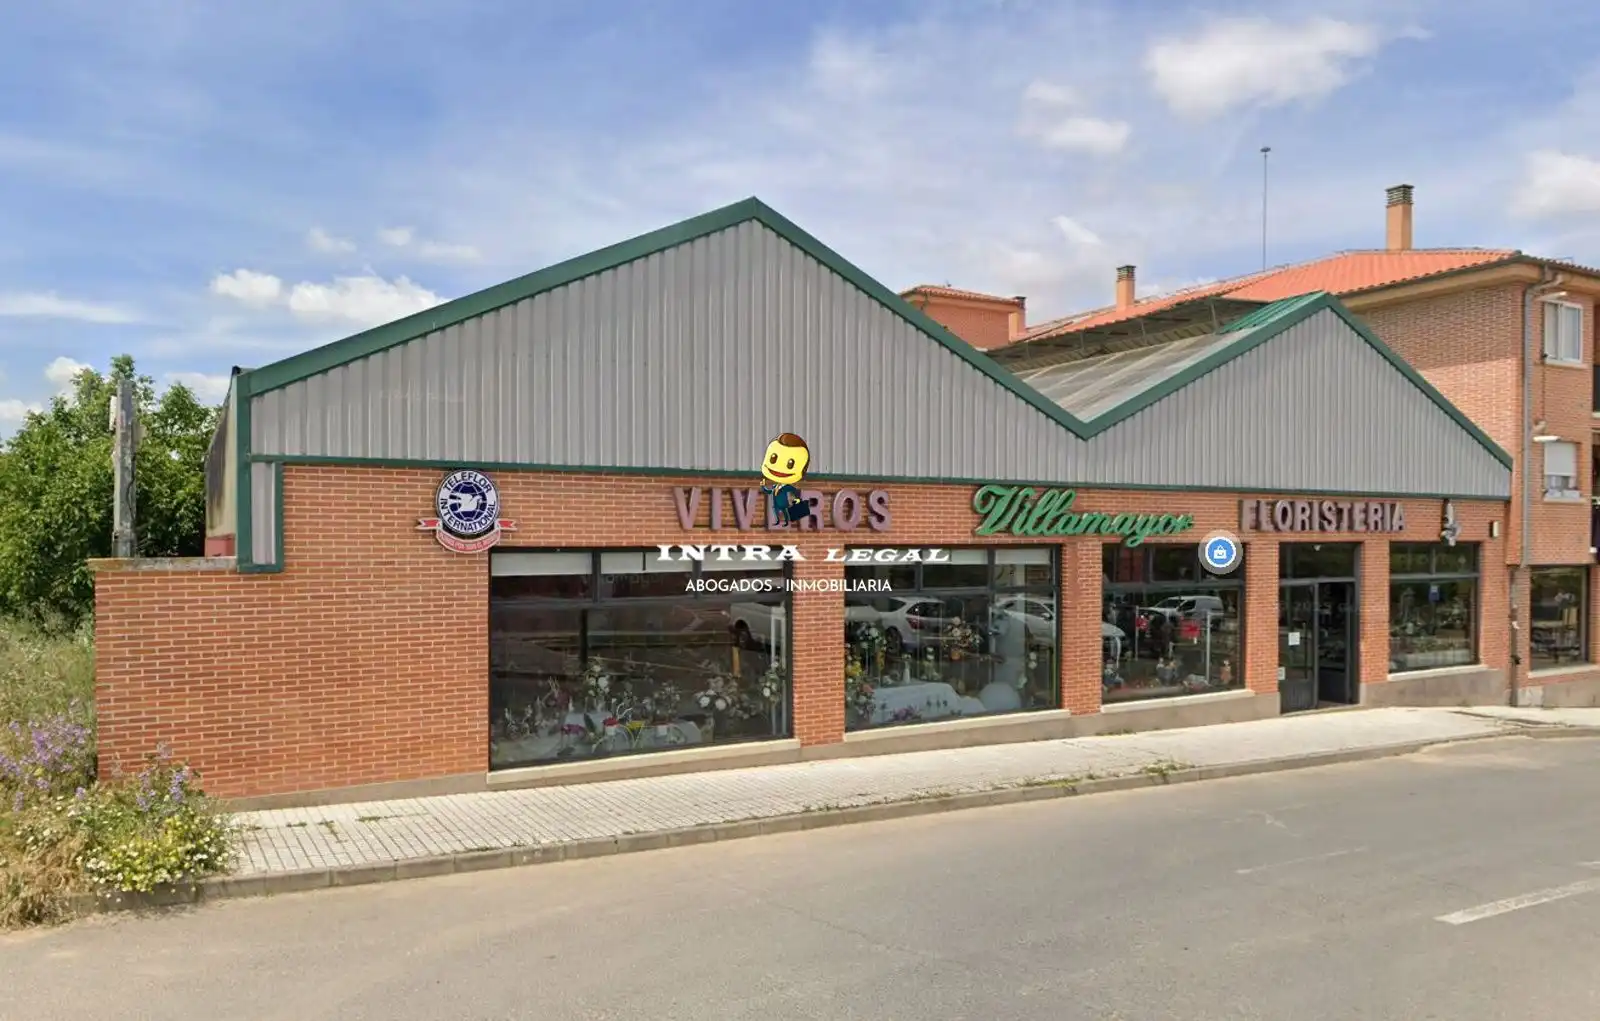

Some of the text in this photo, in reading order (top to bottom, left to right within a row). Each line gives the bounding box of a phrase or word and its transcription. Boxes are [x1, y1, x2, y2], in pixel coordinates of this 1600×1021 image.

[443, 472, 492, 492] TELEFLOR
[440, 498, 496, 531] INTERNATIONAL
[973, 485, 1194, 547] Villamayor
[1240, 499, 1406, 533] FLORISTERIA
